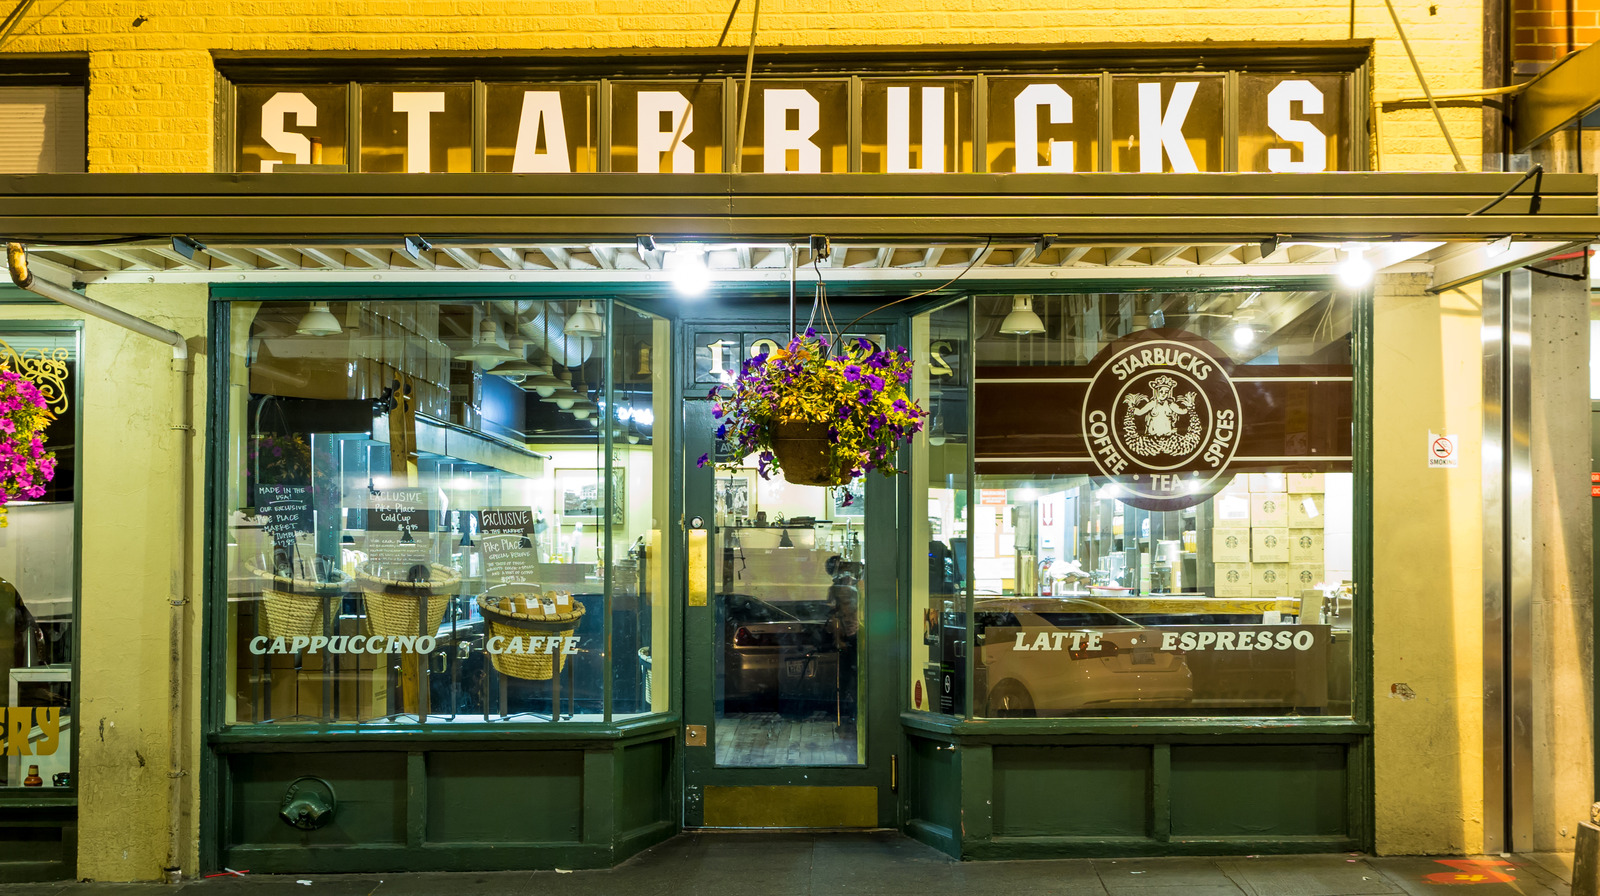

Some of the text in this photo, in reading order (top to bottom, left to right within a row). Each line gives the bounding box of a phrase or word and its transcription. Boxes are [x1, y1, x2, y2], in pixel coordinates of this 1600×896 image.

[260, 80, 1327, 173] STARBUCKS
[1111, 347, 1213, 381] STARBUCKS
[1088, 409, 1129, 476] COFFEE
[1203, 408, 1235, 468] SPICES
[1149, 473, 1185, 492] TEA
[369, 492, 422, 501] EXCLUSIVE
[276, 514, 299, 523] PLACE
[380, 513, 411, 524] Cold Cup
[249, 634, 582, 655] CAPPUCCINO CAFFE
[1012, 629, 1315, 651] LATTE ESPRESSO
[0, 706, 61, 756] RY
